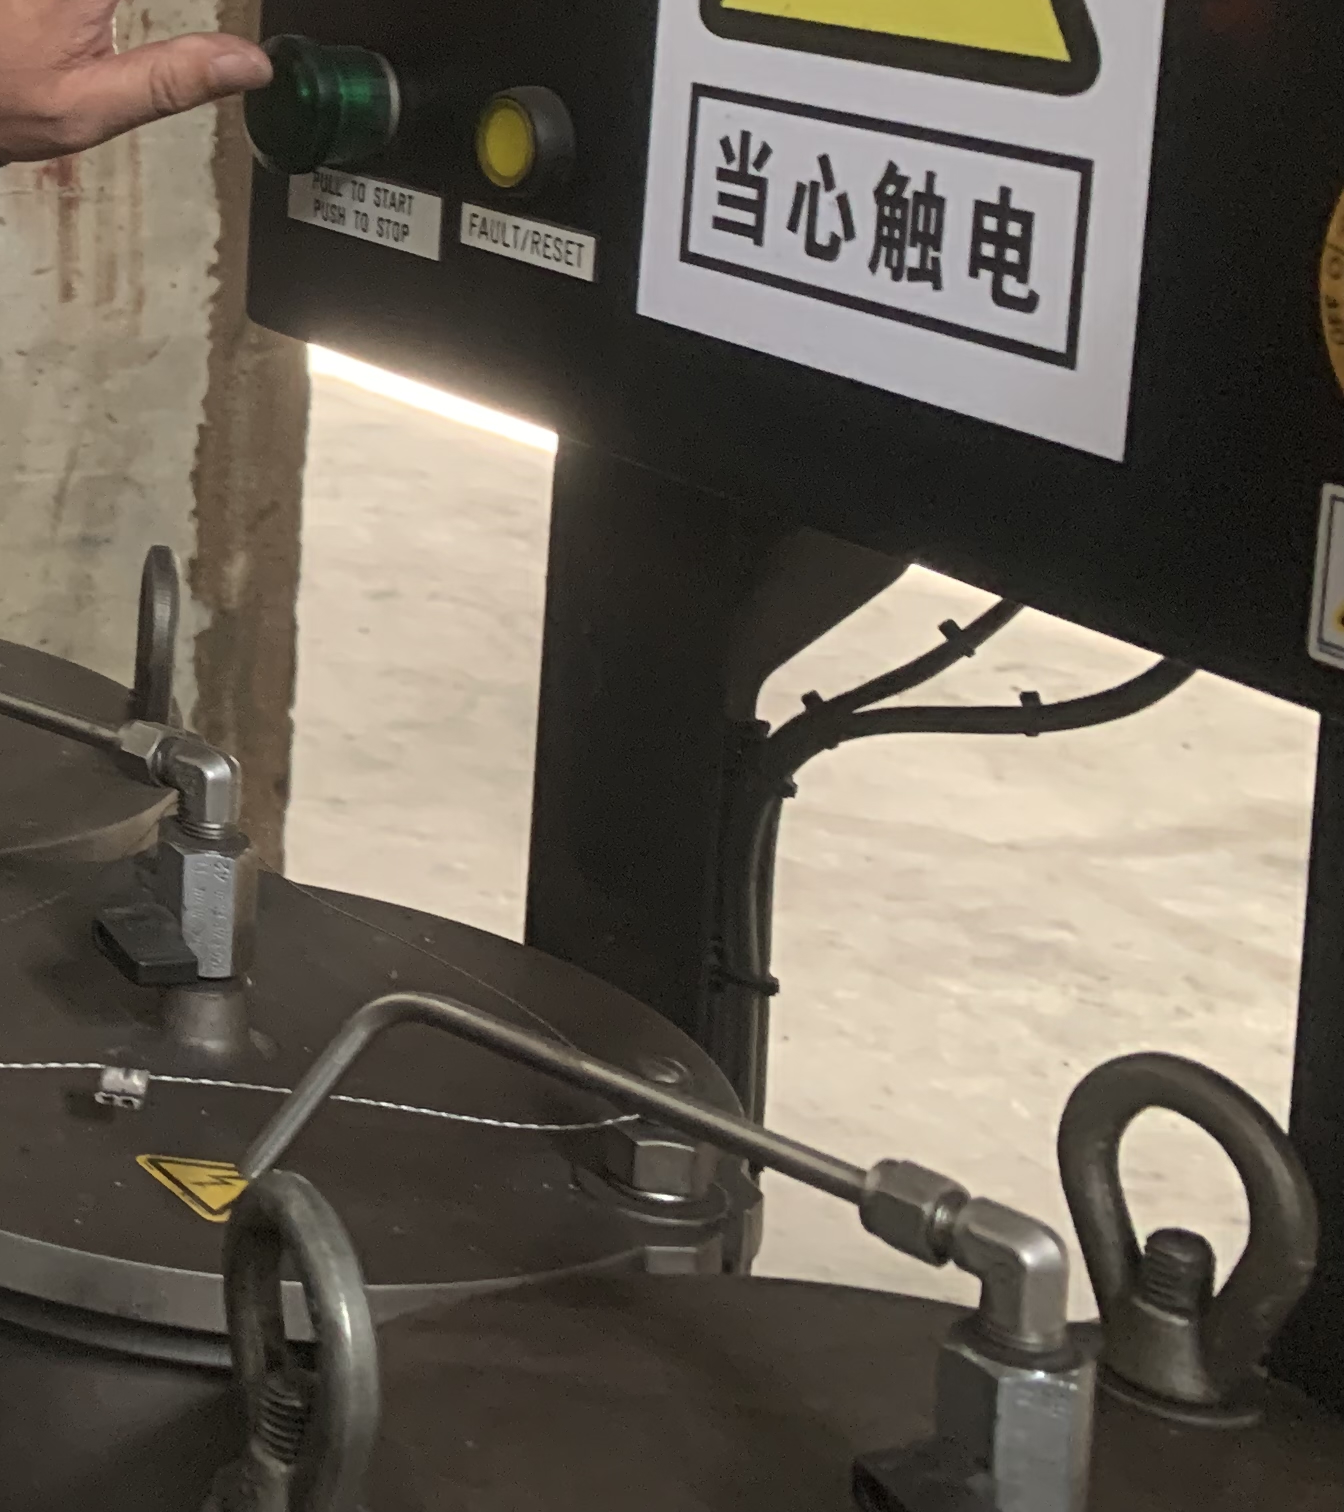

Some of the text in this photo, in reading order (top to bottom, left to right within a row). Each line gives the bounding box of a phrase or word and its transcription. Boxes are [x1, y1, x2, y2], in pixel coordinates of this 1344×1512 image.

[313, 170, 415, 217] PULL TO START
[313, 198, 410, 243] PUSH TO STOP
[468, 212, 585, 269] FAULT/RESET
[712, 129, 1040, 314] 当心触电
